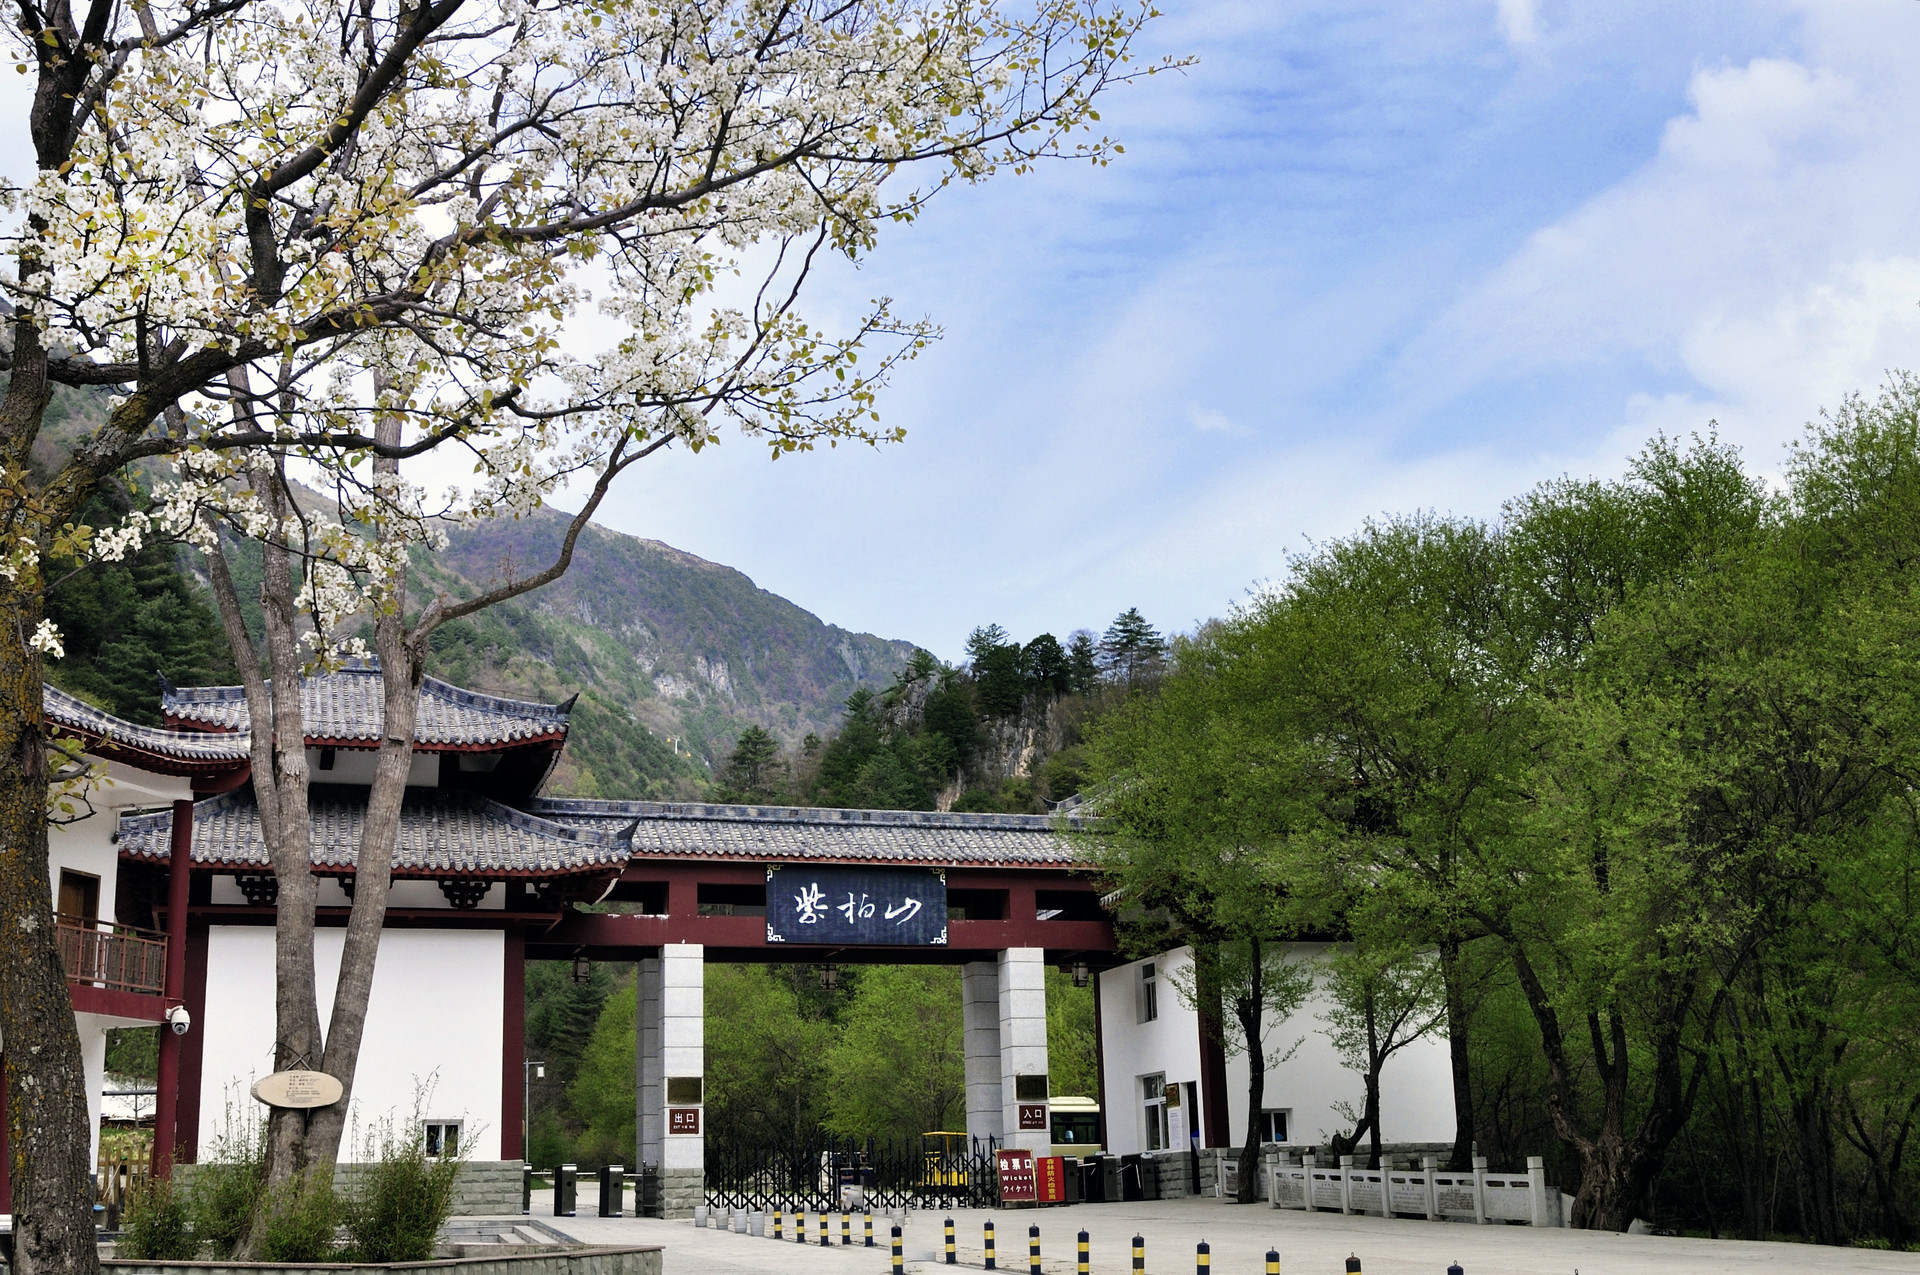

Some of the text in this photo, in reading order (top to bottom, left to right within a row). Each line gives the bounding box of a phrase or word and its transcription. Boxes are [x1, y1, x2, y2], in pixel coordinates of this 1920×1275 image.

[794, 882, 922, 926] 紫柏山
[674, 1112, 694, 1124] 出口
[1023, 1109, 1042, 1119] 入口
[1000, 1158, 1032, 1171] 检票口
